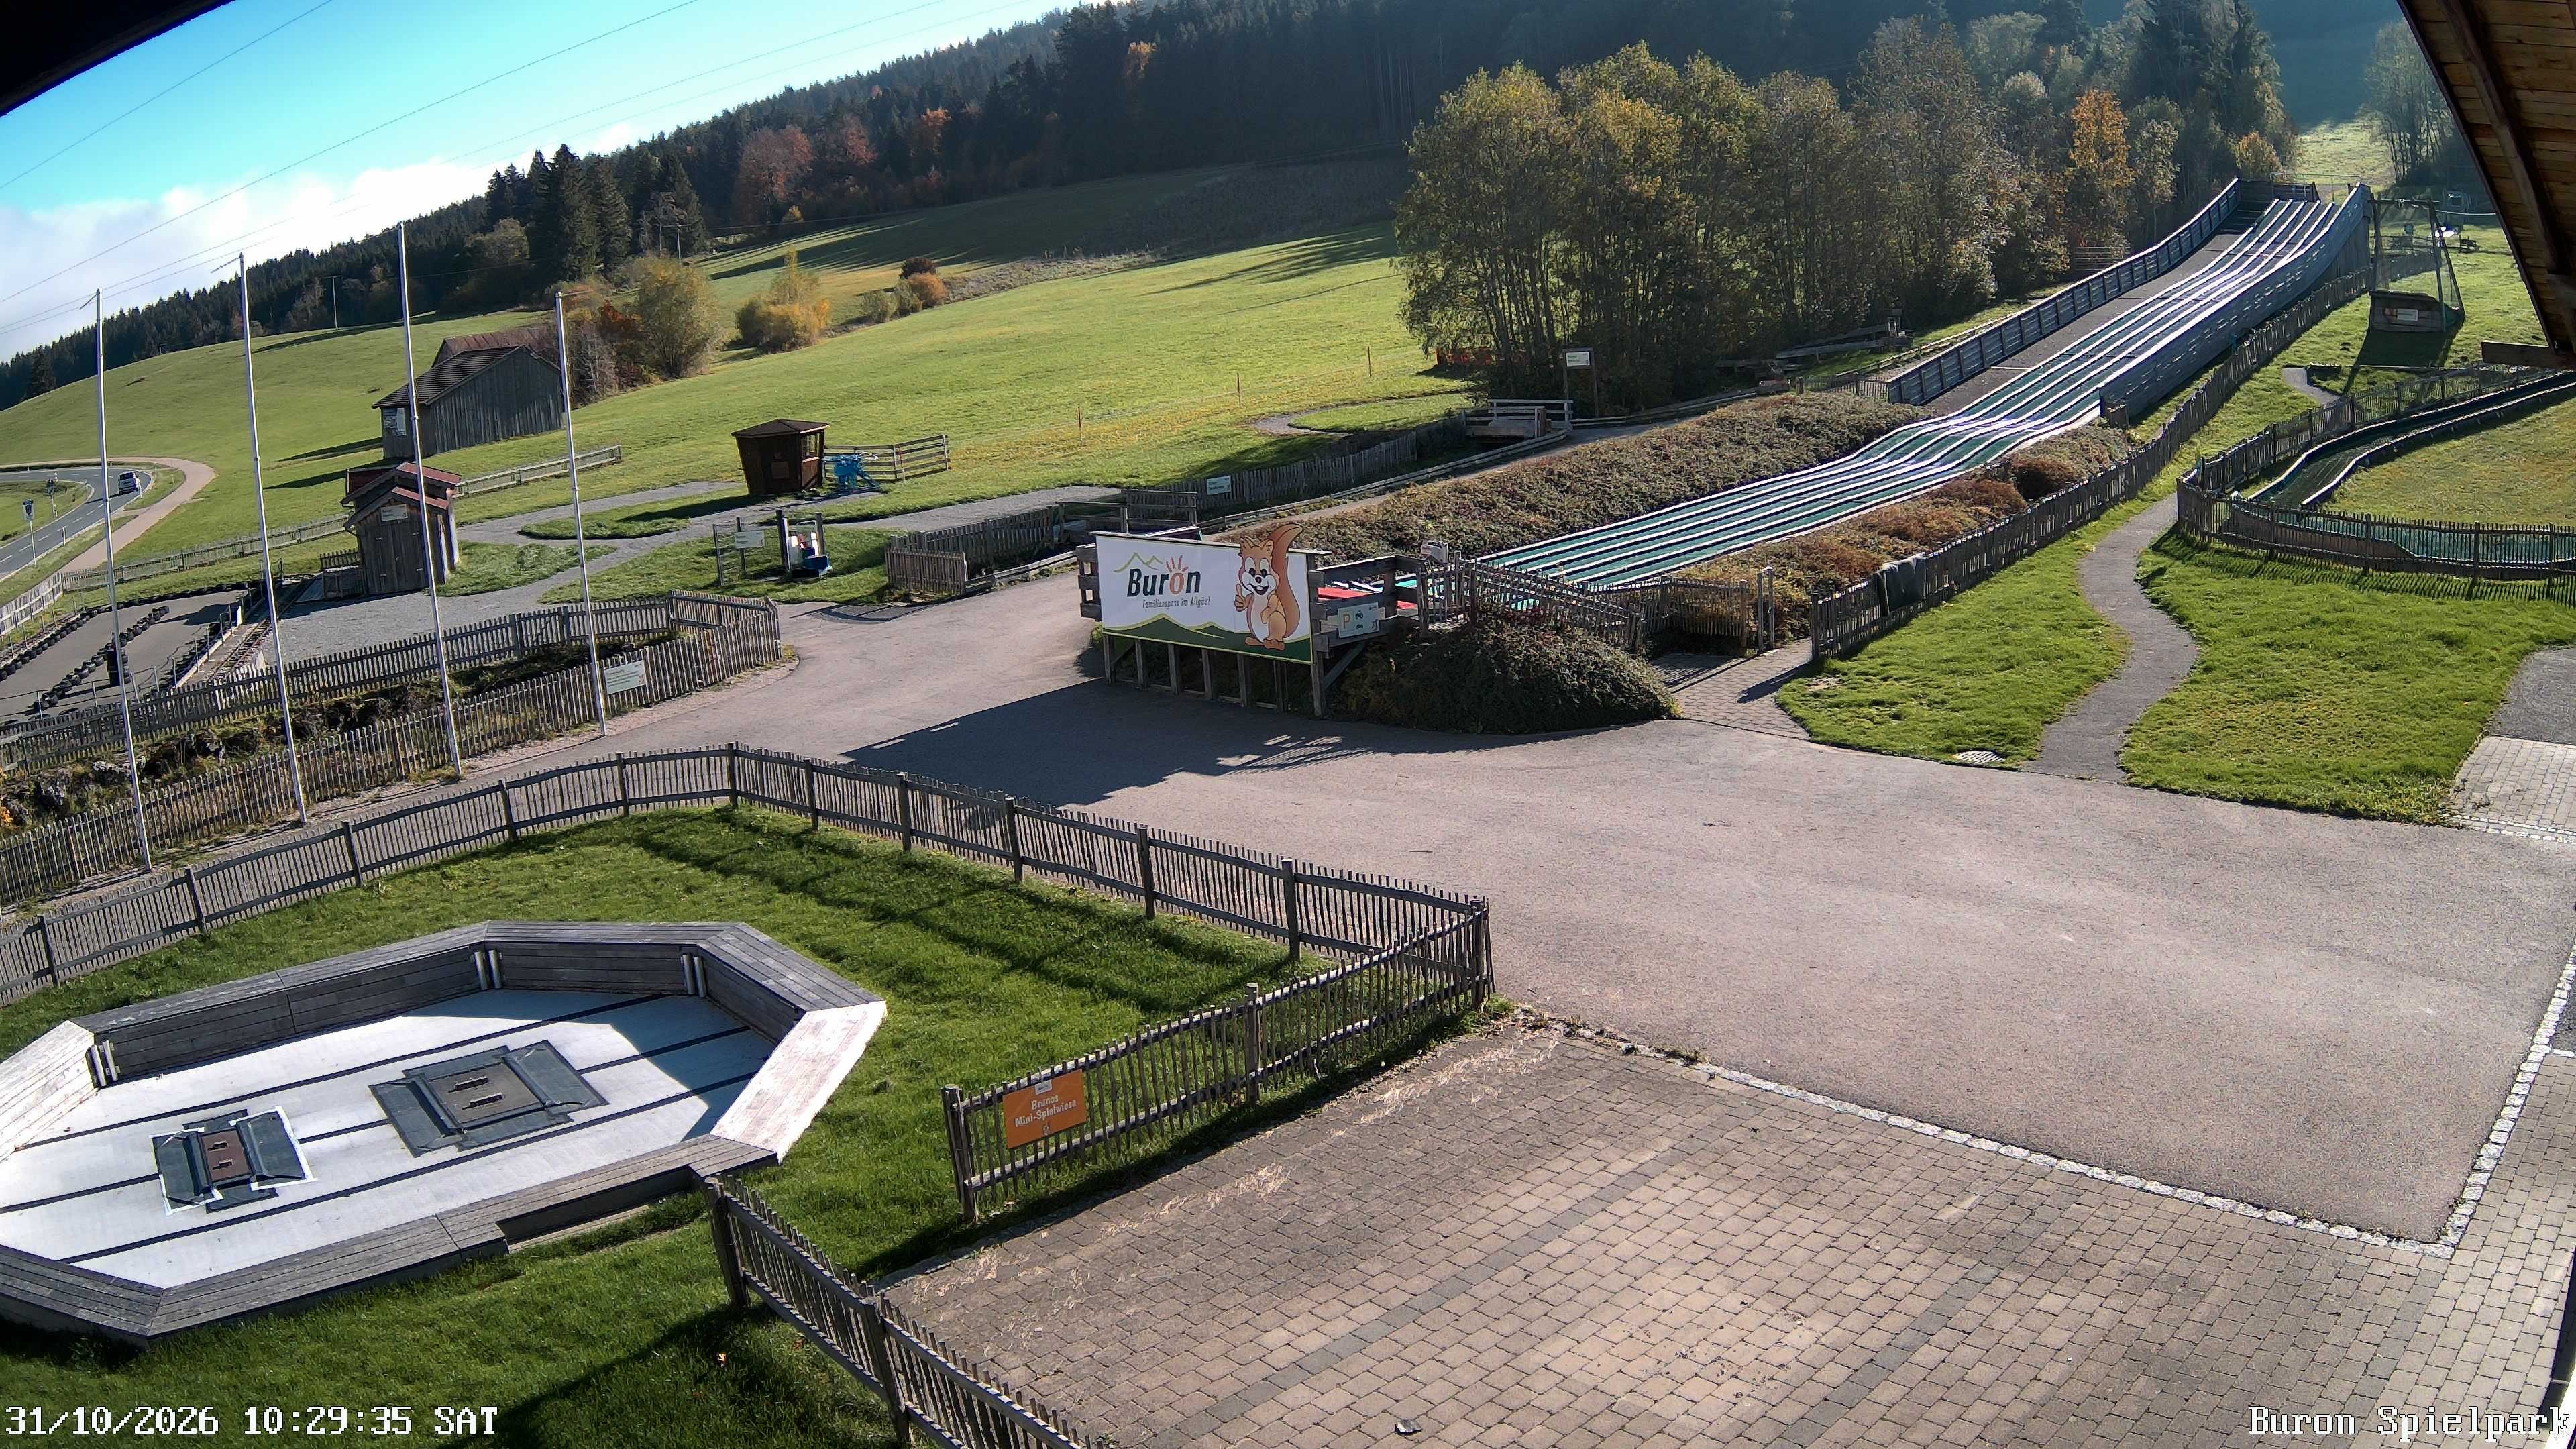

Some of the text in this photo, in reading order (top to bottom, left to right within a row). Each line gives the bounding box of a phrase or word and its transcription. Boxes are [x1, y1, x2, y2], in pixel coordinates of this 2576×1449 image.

[1127, 568, 1201, 597] Buron
[1343, 614, 1350, 629] P
[1014, 1099, 1077, 1127] Mini-Spielwiese
[1031, 1095, 1059, 1110] Brunos
